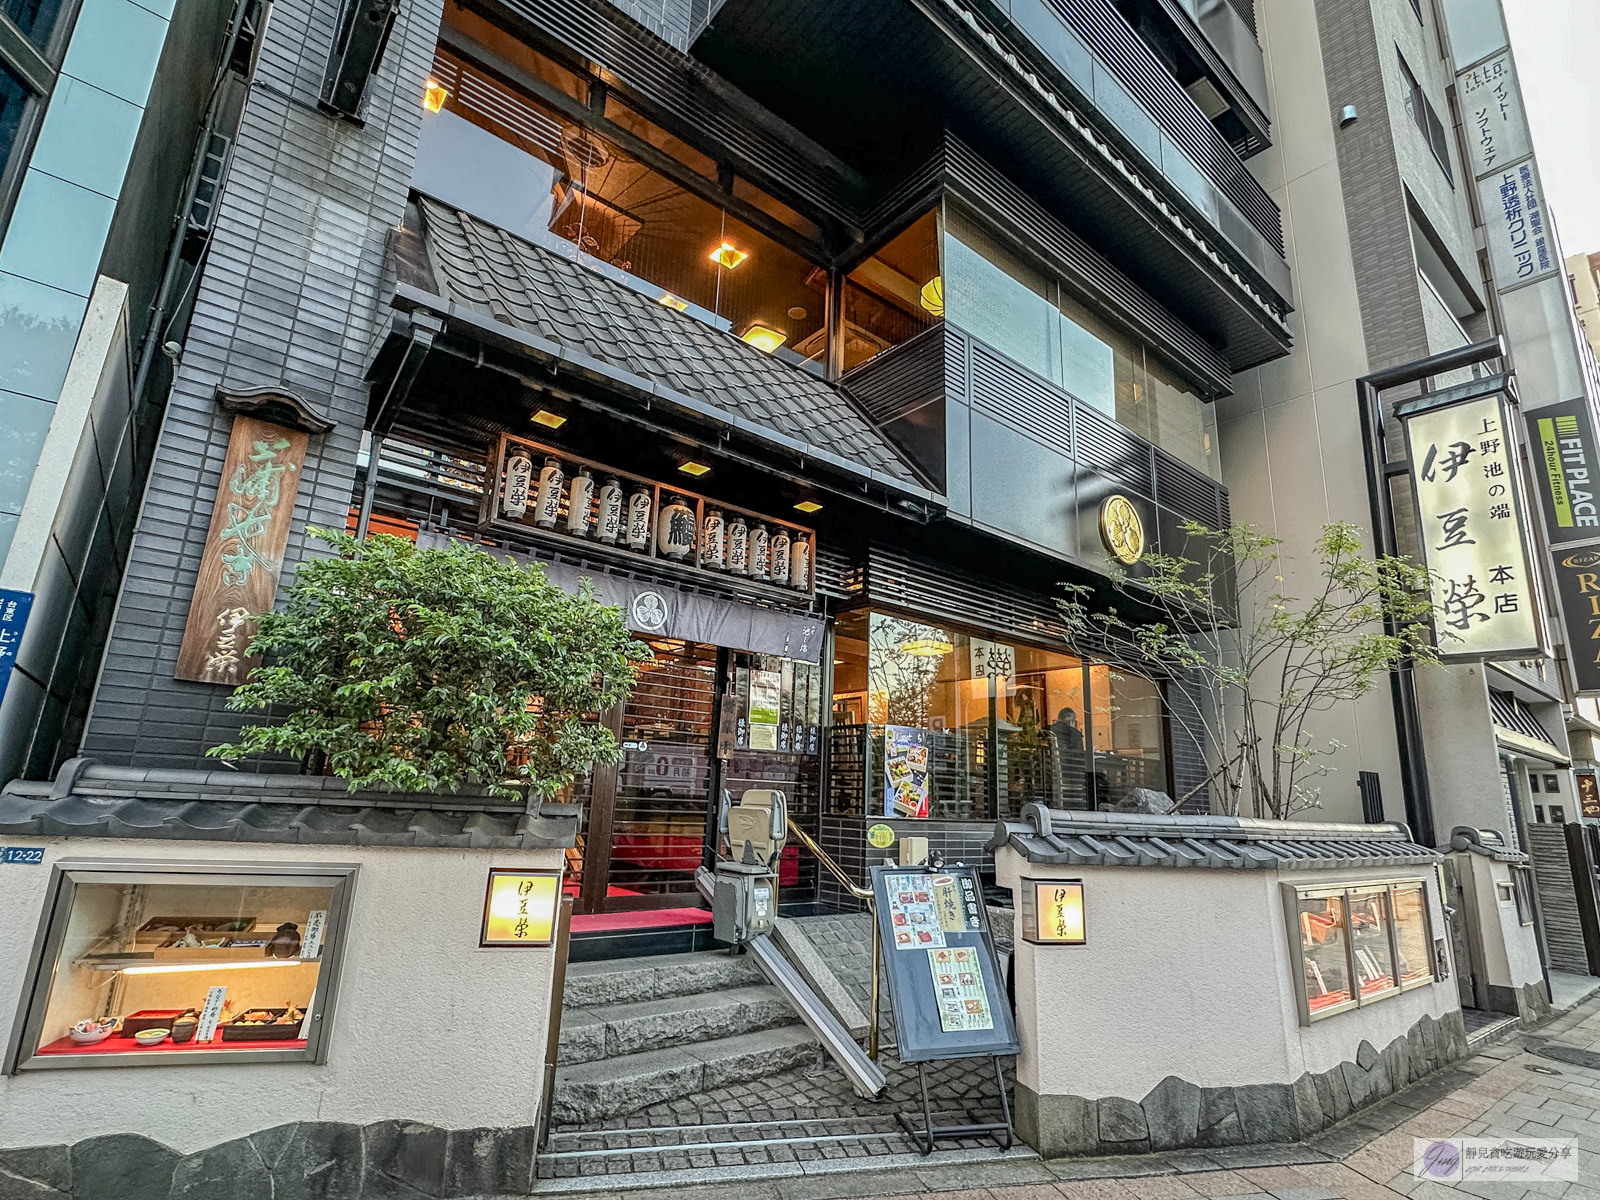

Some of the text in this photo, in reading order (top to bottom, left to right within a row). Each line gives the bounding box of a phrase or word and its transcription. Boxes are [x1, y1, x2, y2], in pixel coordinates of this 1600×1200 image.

[1493, 81, 1507, 121] イットー
[1475, 107, 1497, 166] ソフトウェア
[1500, 173, 1534, 279] 上野透析クリニック
[1544, 440, 1564, 505] 24hour Fitness
[1560, 438, 1600, 527] FIT PLACE
[1477, 418, 1519, 614] 上野池の端 本店
[2, 600, 18, 622] 台東区
[942, 886, 956, 921] 肝焼き
